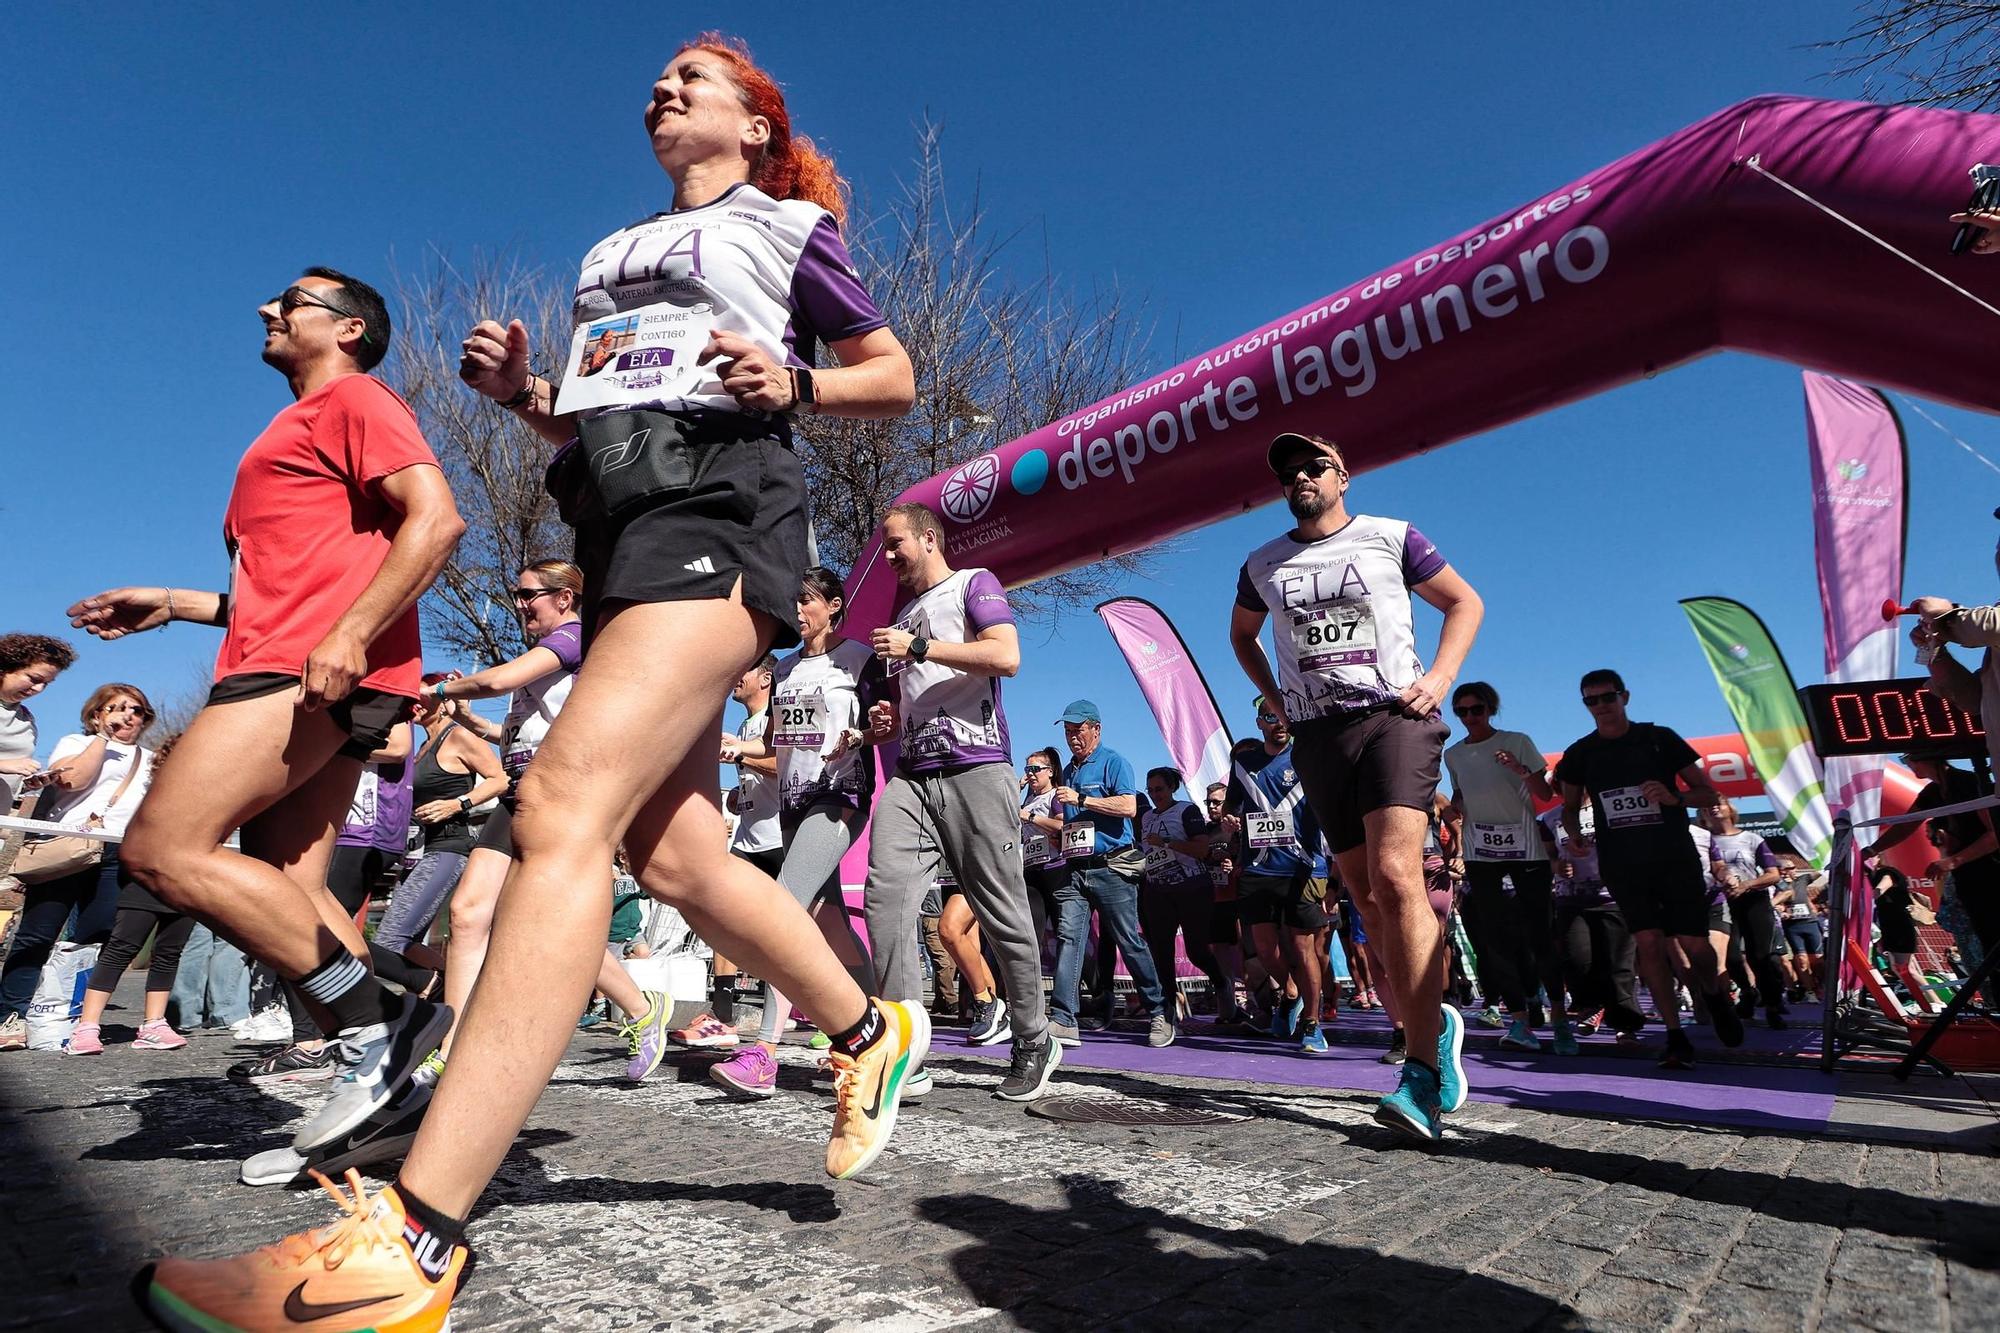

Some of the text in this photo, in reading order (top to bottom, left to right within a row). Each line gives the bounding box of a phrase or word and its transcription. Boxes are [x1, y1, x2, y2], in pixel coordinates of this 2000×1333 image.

[616, 286, 652, 300] LATERAL
[1057, 182, 1593, 437] Organismo Autónomo de Deportes
[643, 312, 690, 325] SIEMPRE
[641, 330, 686, 341] CONTIGO
[629, 352, 662, 367] ELA
[1056, 224, 1611, 491] deporte lagunero
[950, 525, 1014, 556] LA LAGUNA
[1286, 563, 1327, 577] CARRERA
[1329, 556, 1346, 567] POR
[1349, 553, 1361, 562] LA
[1280, 563, 1371, 612] ELA
[1307, 621, 1358, 646] 807
[782, 709, 815, 725] 287
[1832, 689, 1985, 742] 00:0
[1613, 796, 1648, 811] 830
[1256, 820, 1285, 832] 209
[1065, 830, 1086, 843] 764
[1483, 833, 1515, 846] 884
[1025, 842, 1043, 855] 495
[1147, 850, 1167, 864] 843
[847, 1007, 879, 1051] FILA
[402, 1212, 454, 1275] FILA
